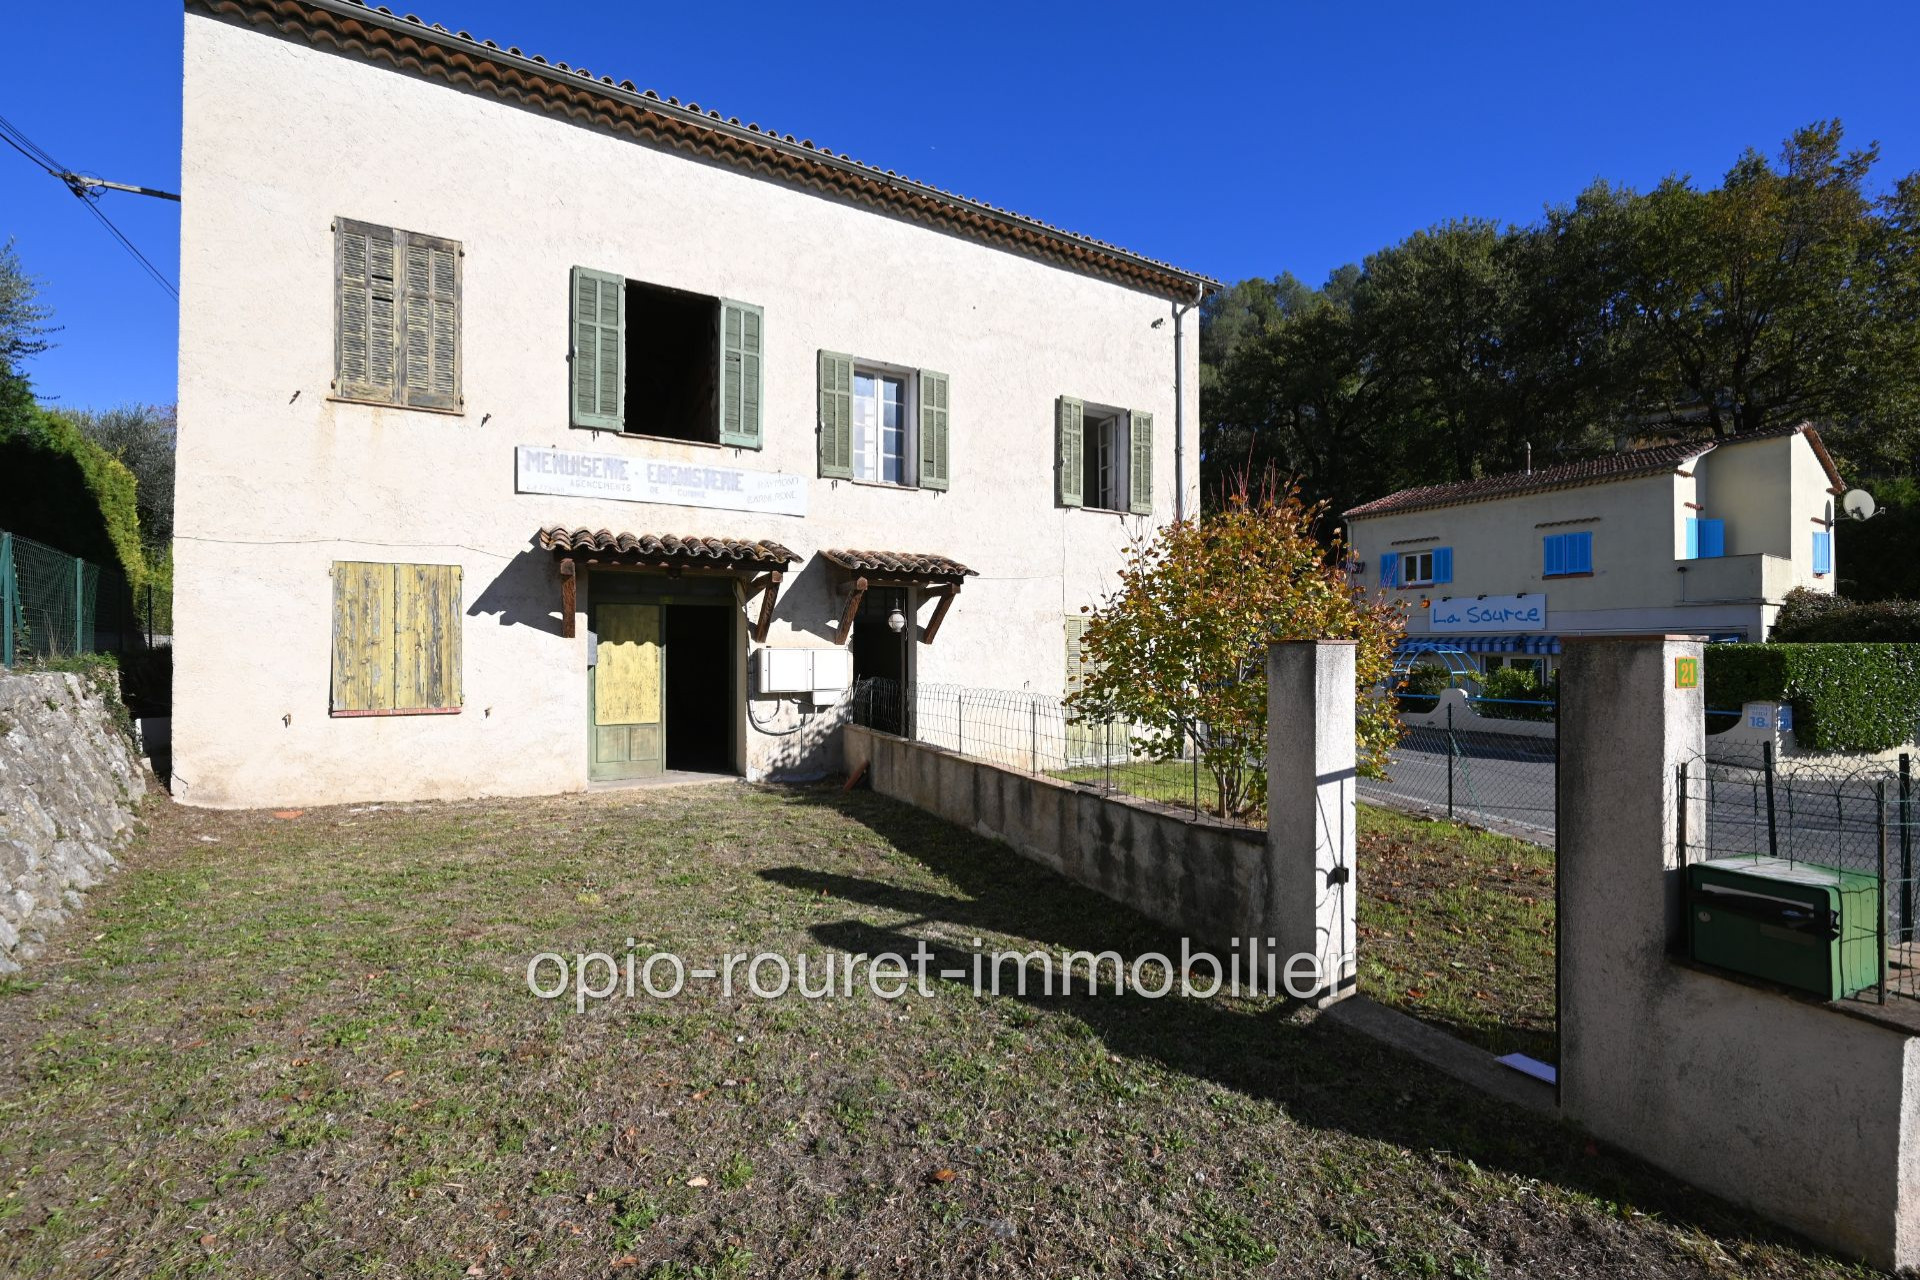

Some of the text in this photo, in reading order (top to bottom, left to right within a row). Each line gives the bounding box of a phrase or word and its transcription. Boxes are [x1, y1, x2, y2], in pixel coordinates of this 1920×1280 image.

[1433, 606, 1540, 624] La Source
[1681, 662, 1695, 684] 21
